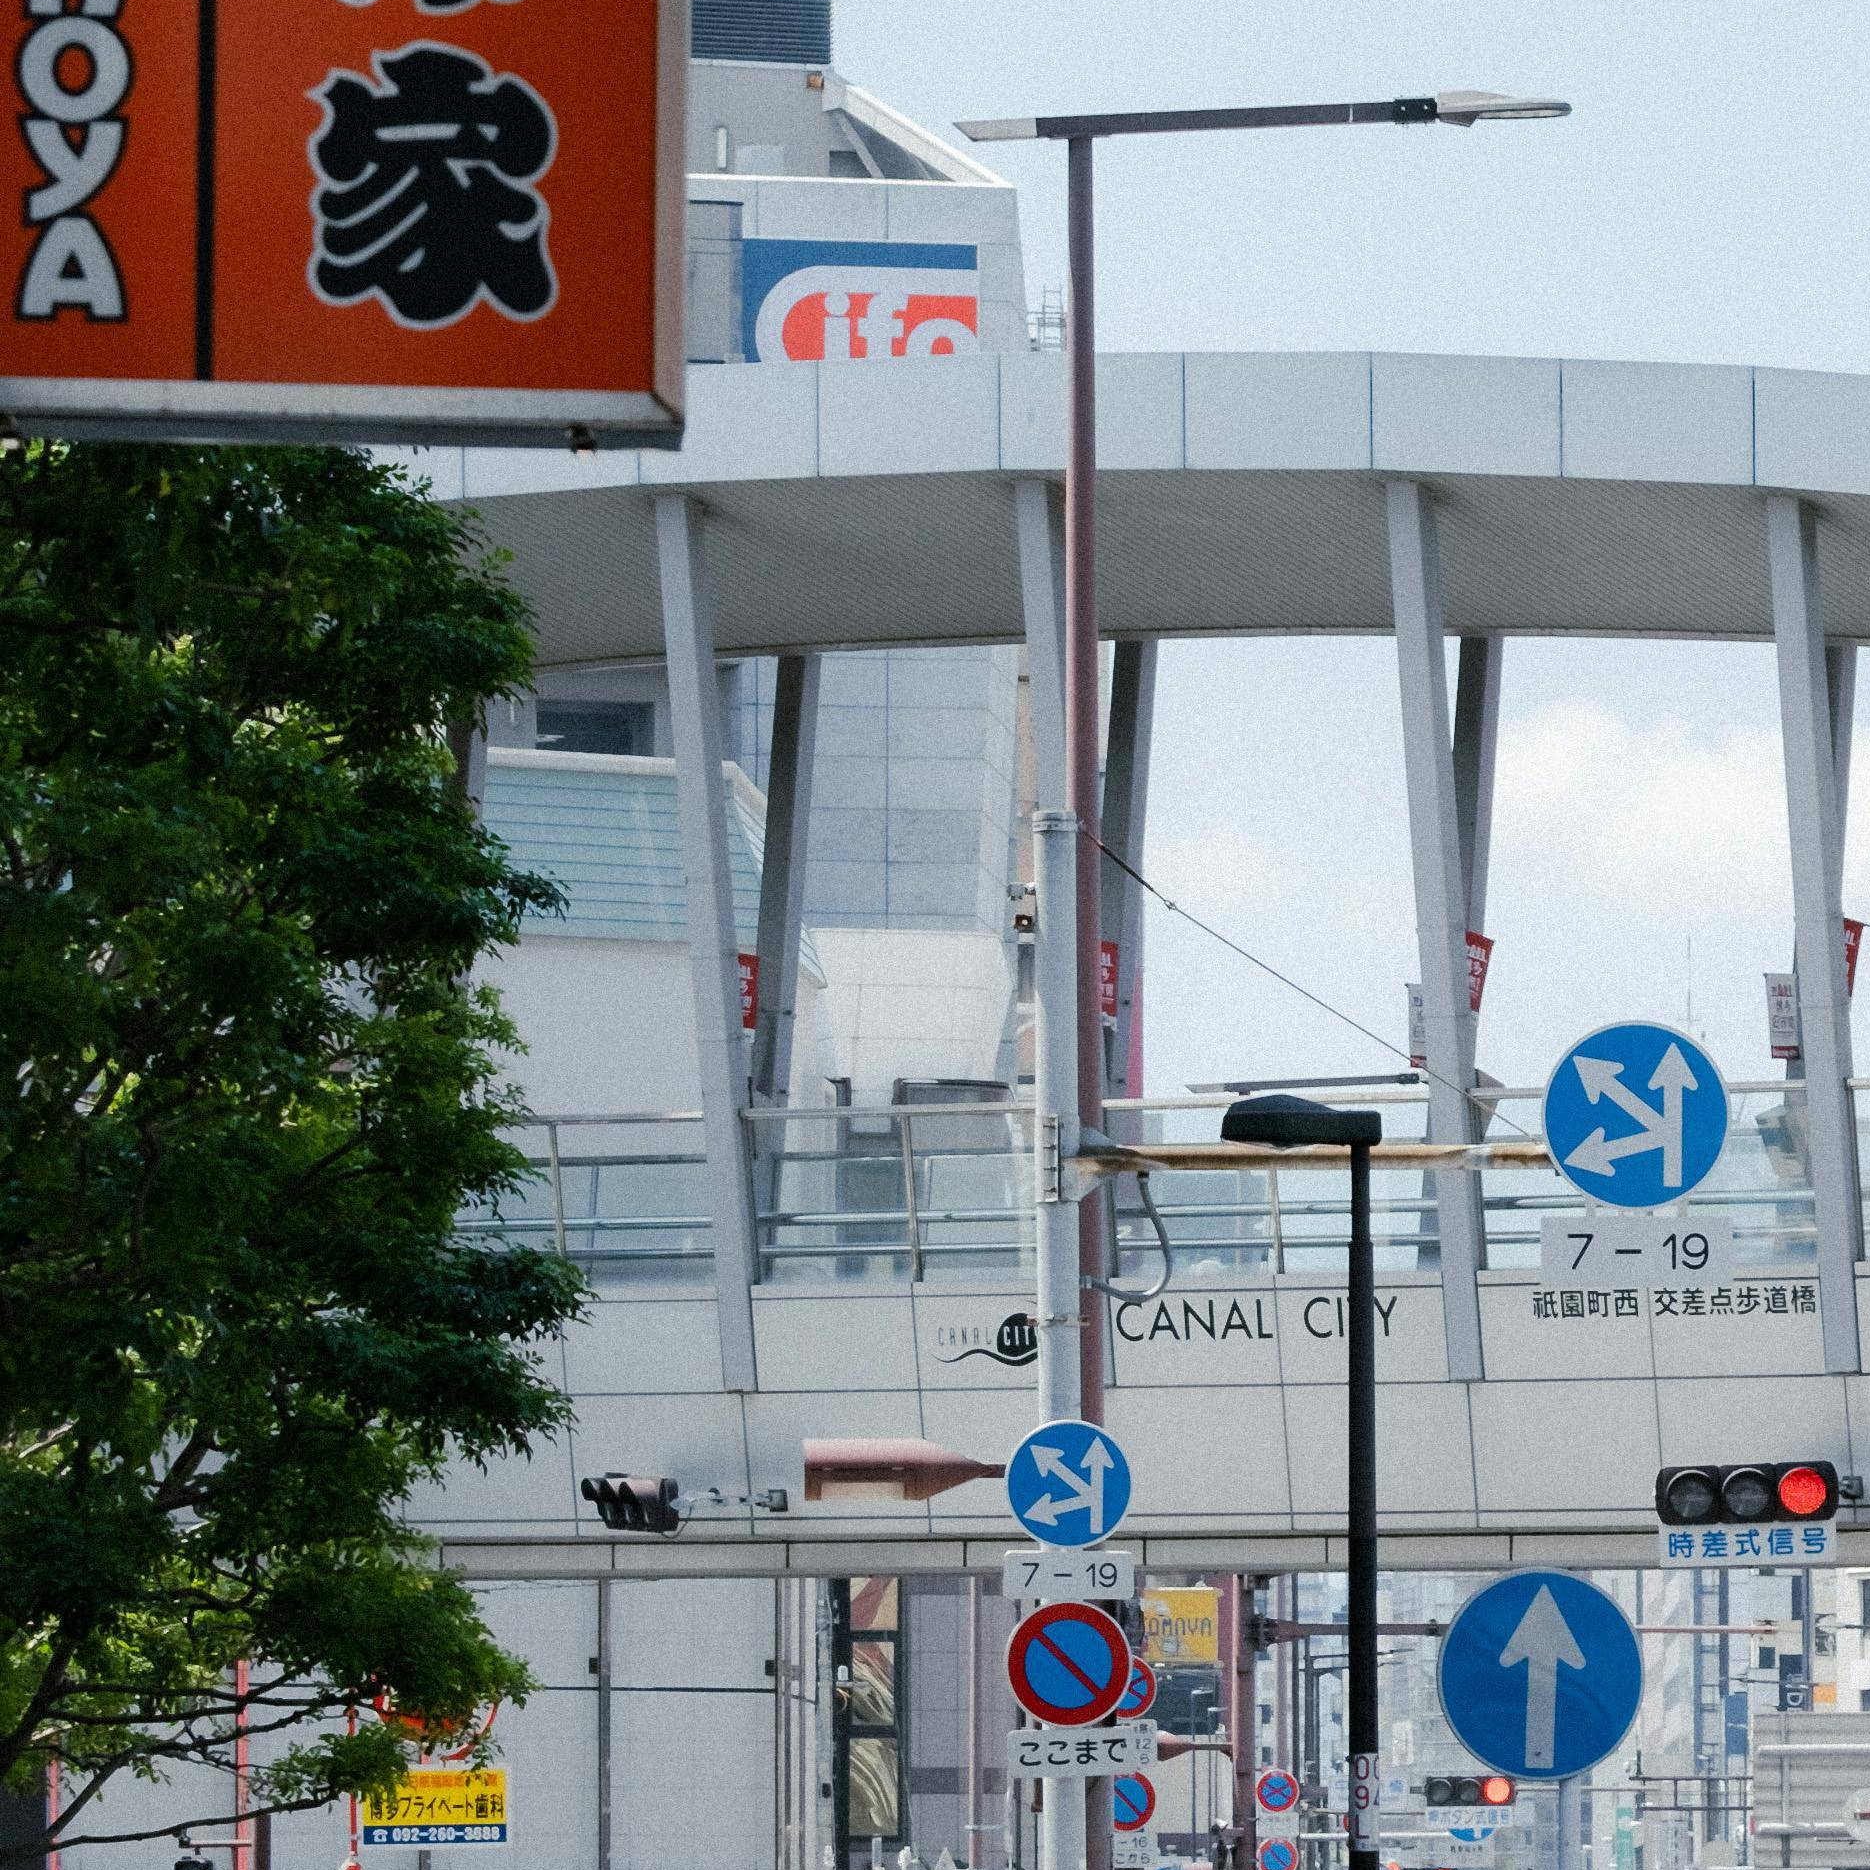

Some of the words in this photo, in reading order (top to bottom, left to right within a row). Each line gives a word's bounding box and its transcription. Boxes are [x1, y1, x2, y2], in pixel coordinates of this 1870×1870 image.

[1116, 1296, 1275, 1344] CANAL
[1303, 1294, 1399, 1340] CIY
[1002, 1326, 1038, 1347] CIT
[1667, 1528, 1828, 1560] 時差式信号
[1019, 1737, 1128, 1767] ここまで
